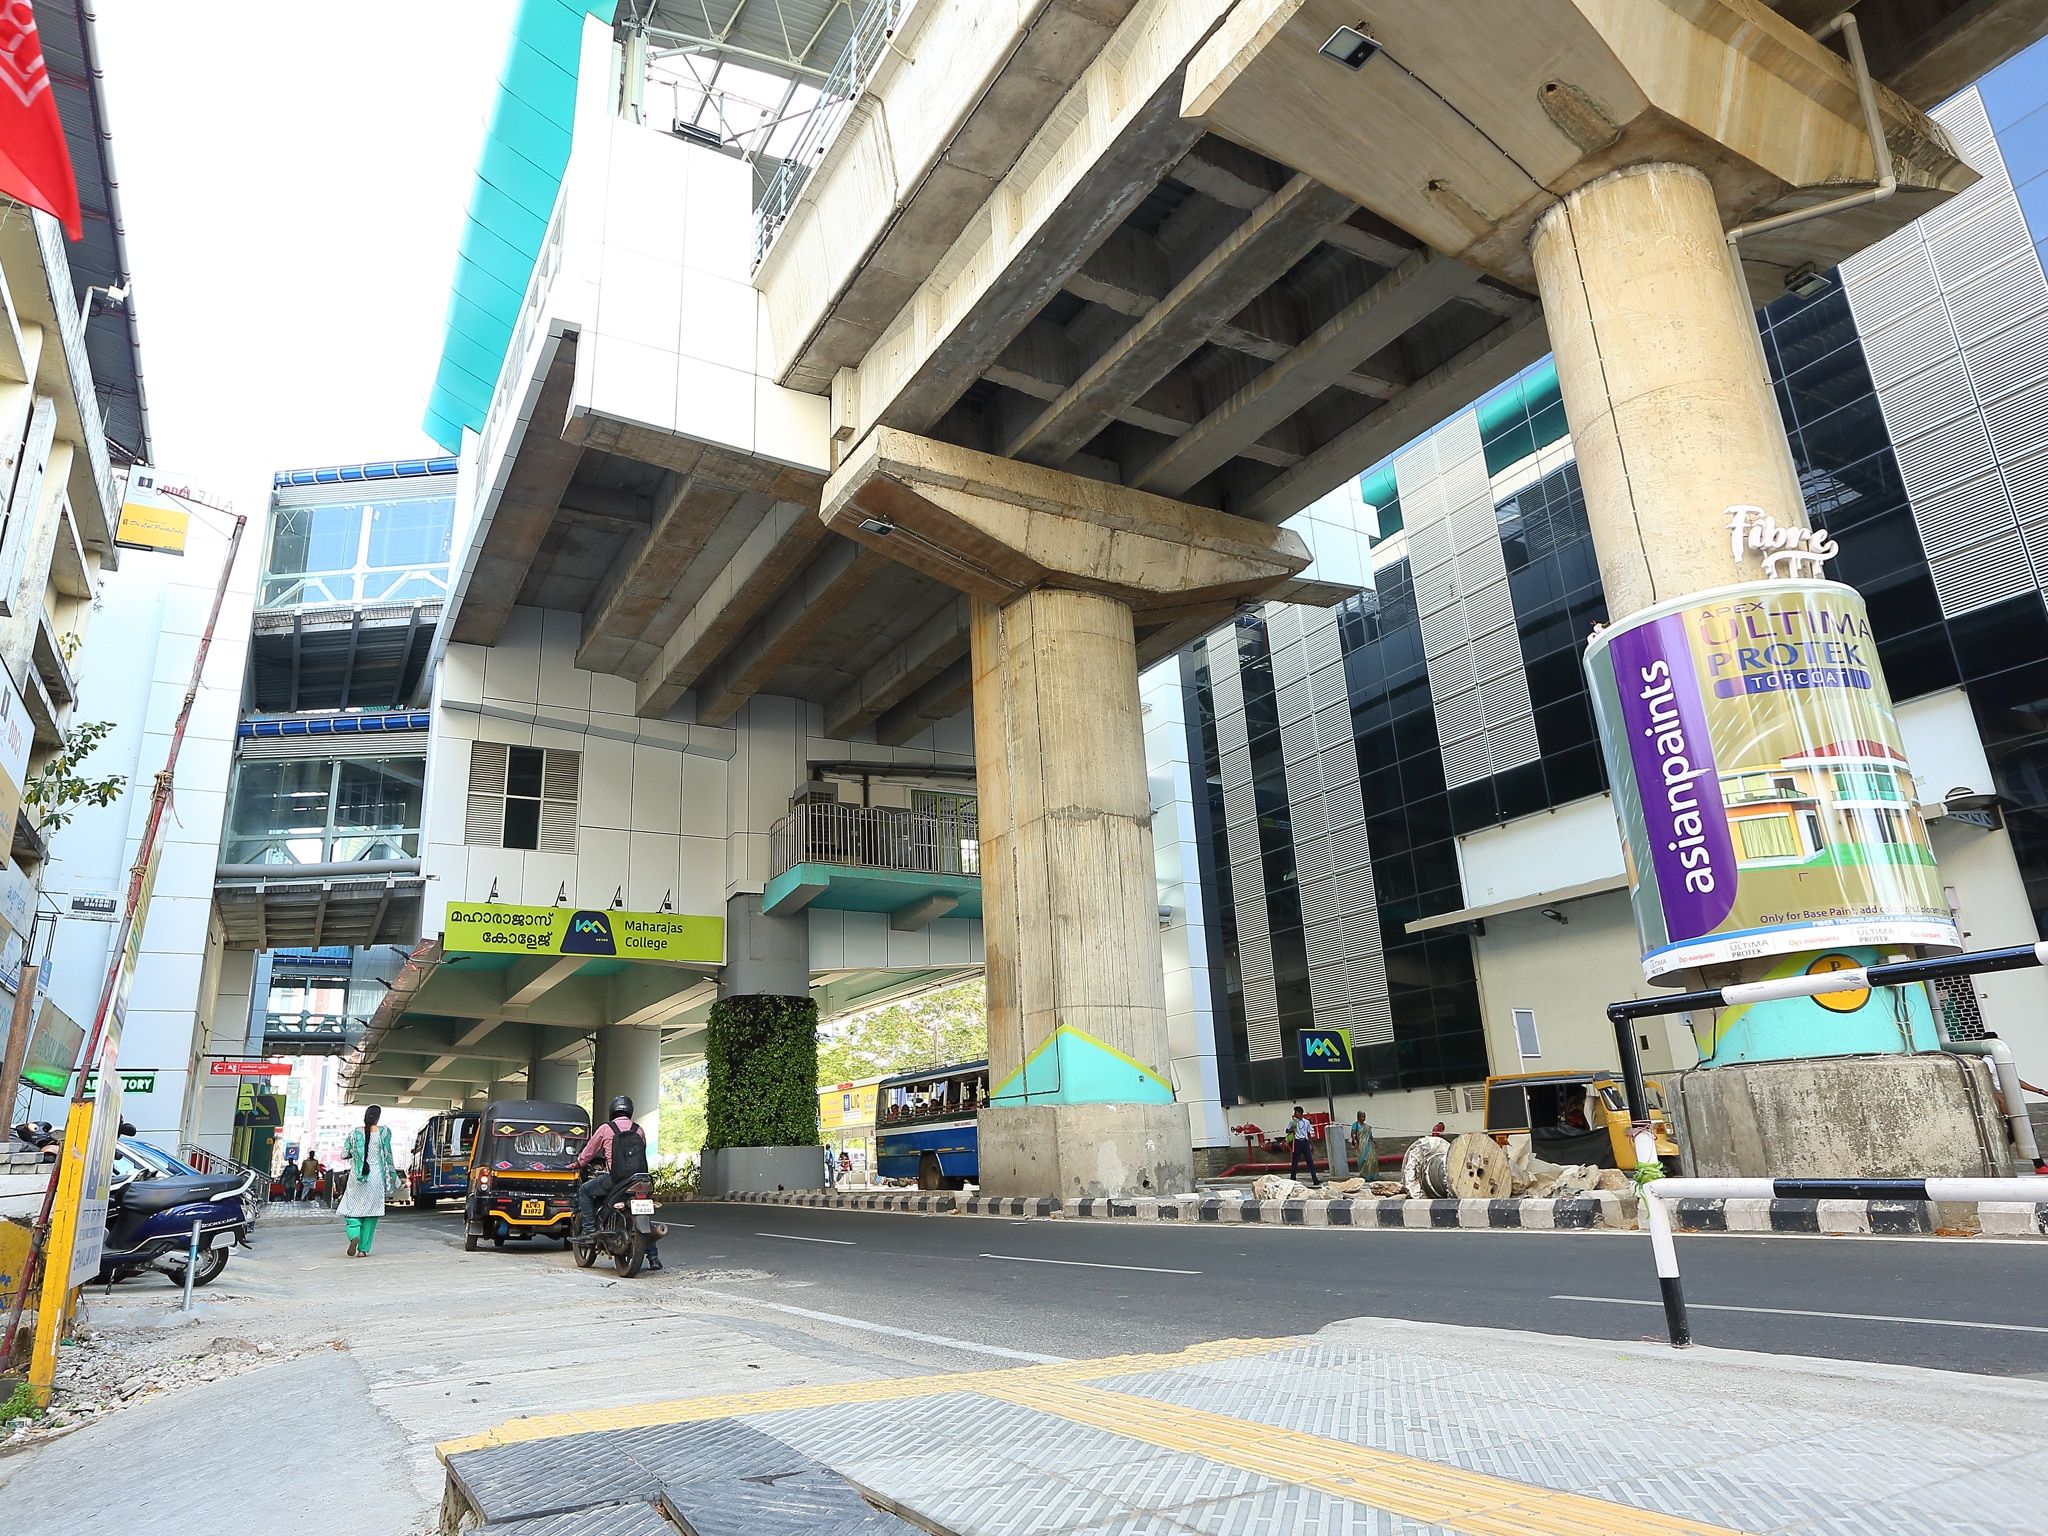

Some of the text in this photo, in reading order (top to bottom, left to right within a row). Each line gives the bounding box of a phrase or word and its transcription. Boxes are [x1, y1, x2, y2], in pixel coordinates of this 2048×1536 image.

[1723, 504, 1839, 565] Fibre
[1699, 601, 1764, 621] APEX
[1700, 610, 1873, 646] ULTIMA
[1706, 641, 1868, 677] PROTEK
[1751, 671, 1847, 690] TOPCOAT
[1639, 659, 1716, 894] asianpaints
[451, 911, 554, 926] മഹാരാജാസ്
[1760, 914, 1784, 925] Only
[1786, 912, 1801, 921] for
[1803, 908, 1828, 920] Base
[1860, 905, 1878, 914] add
[624, 920, 683, 935] Maharajas
[1856, 926, 1894, 936] ULTIMA
[482, 931, 553, 950] കോളേജ്
[625, 937, 668, 950] College
[1730, 939, 1769, 952] ULTIMA
[1858, 935, 1890, 944] PROTEK
[1731, 949, 1763, 958] PROTEK
